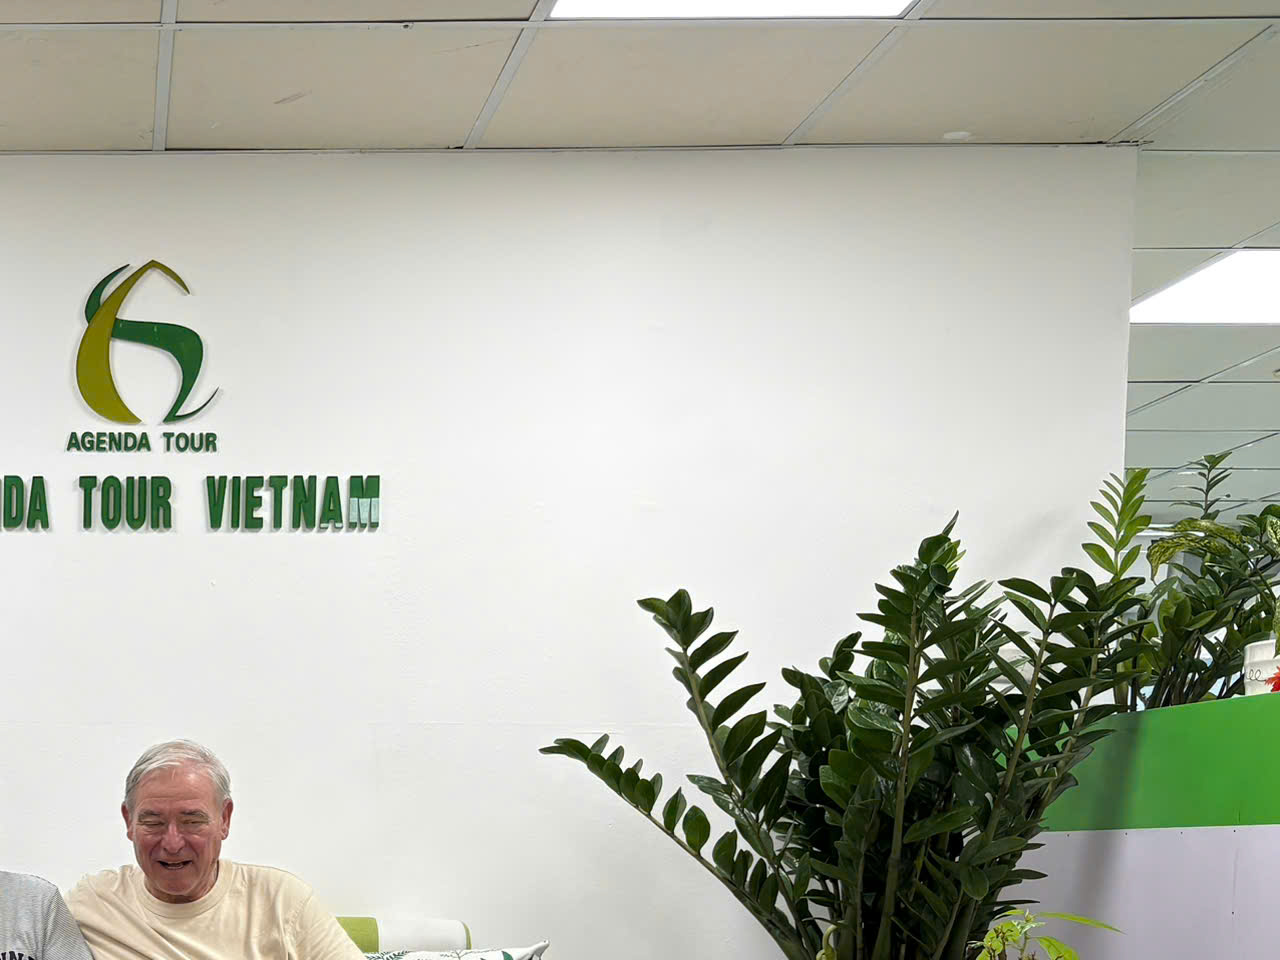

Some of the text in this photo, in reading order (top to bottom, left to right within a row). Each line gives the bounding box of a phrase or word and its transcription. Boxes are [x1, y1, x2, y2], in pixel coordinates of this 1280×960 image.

[66, 432, 218, 452] AGENDA TOUR
[79, 475, 173, 530] TOUR
[206, 475, 381, 530] VIETNAM
